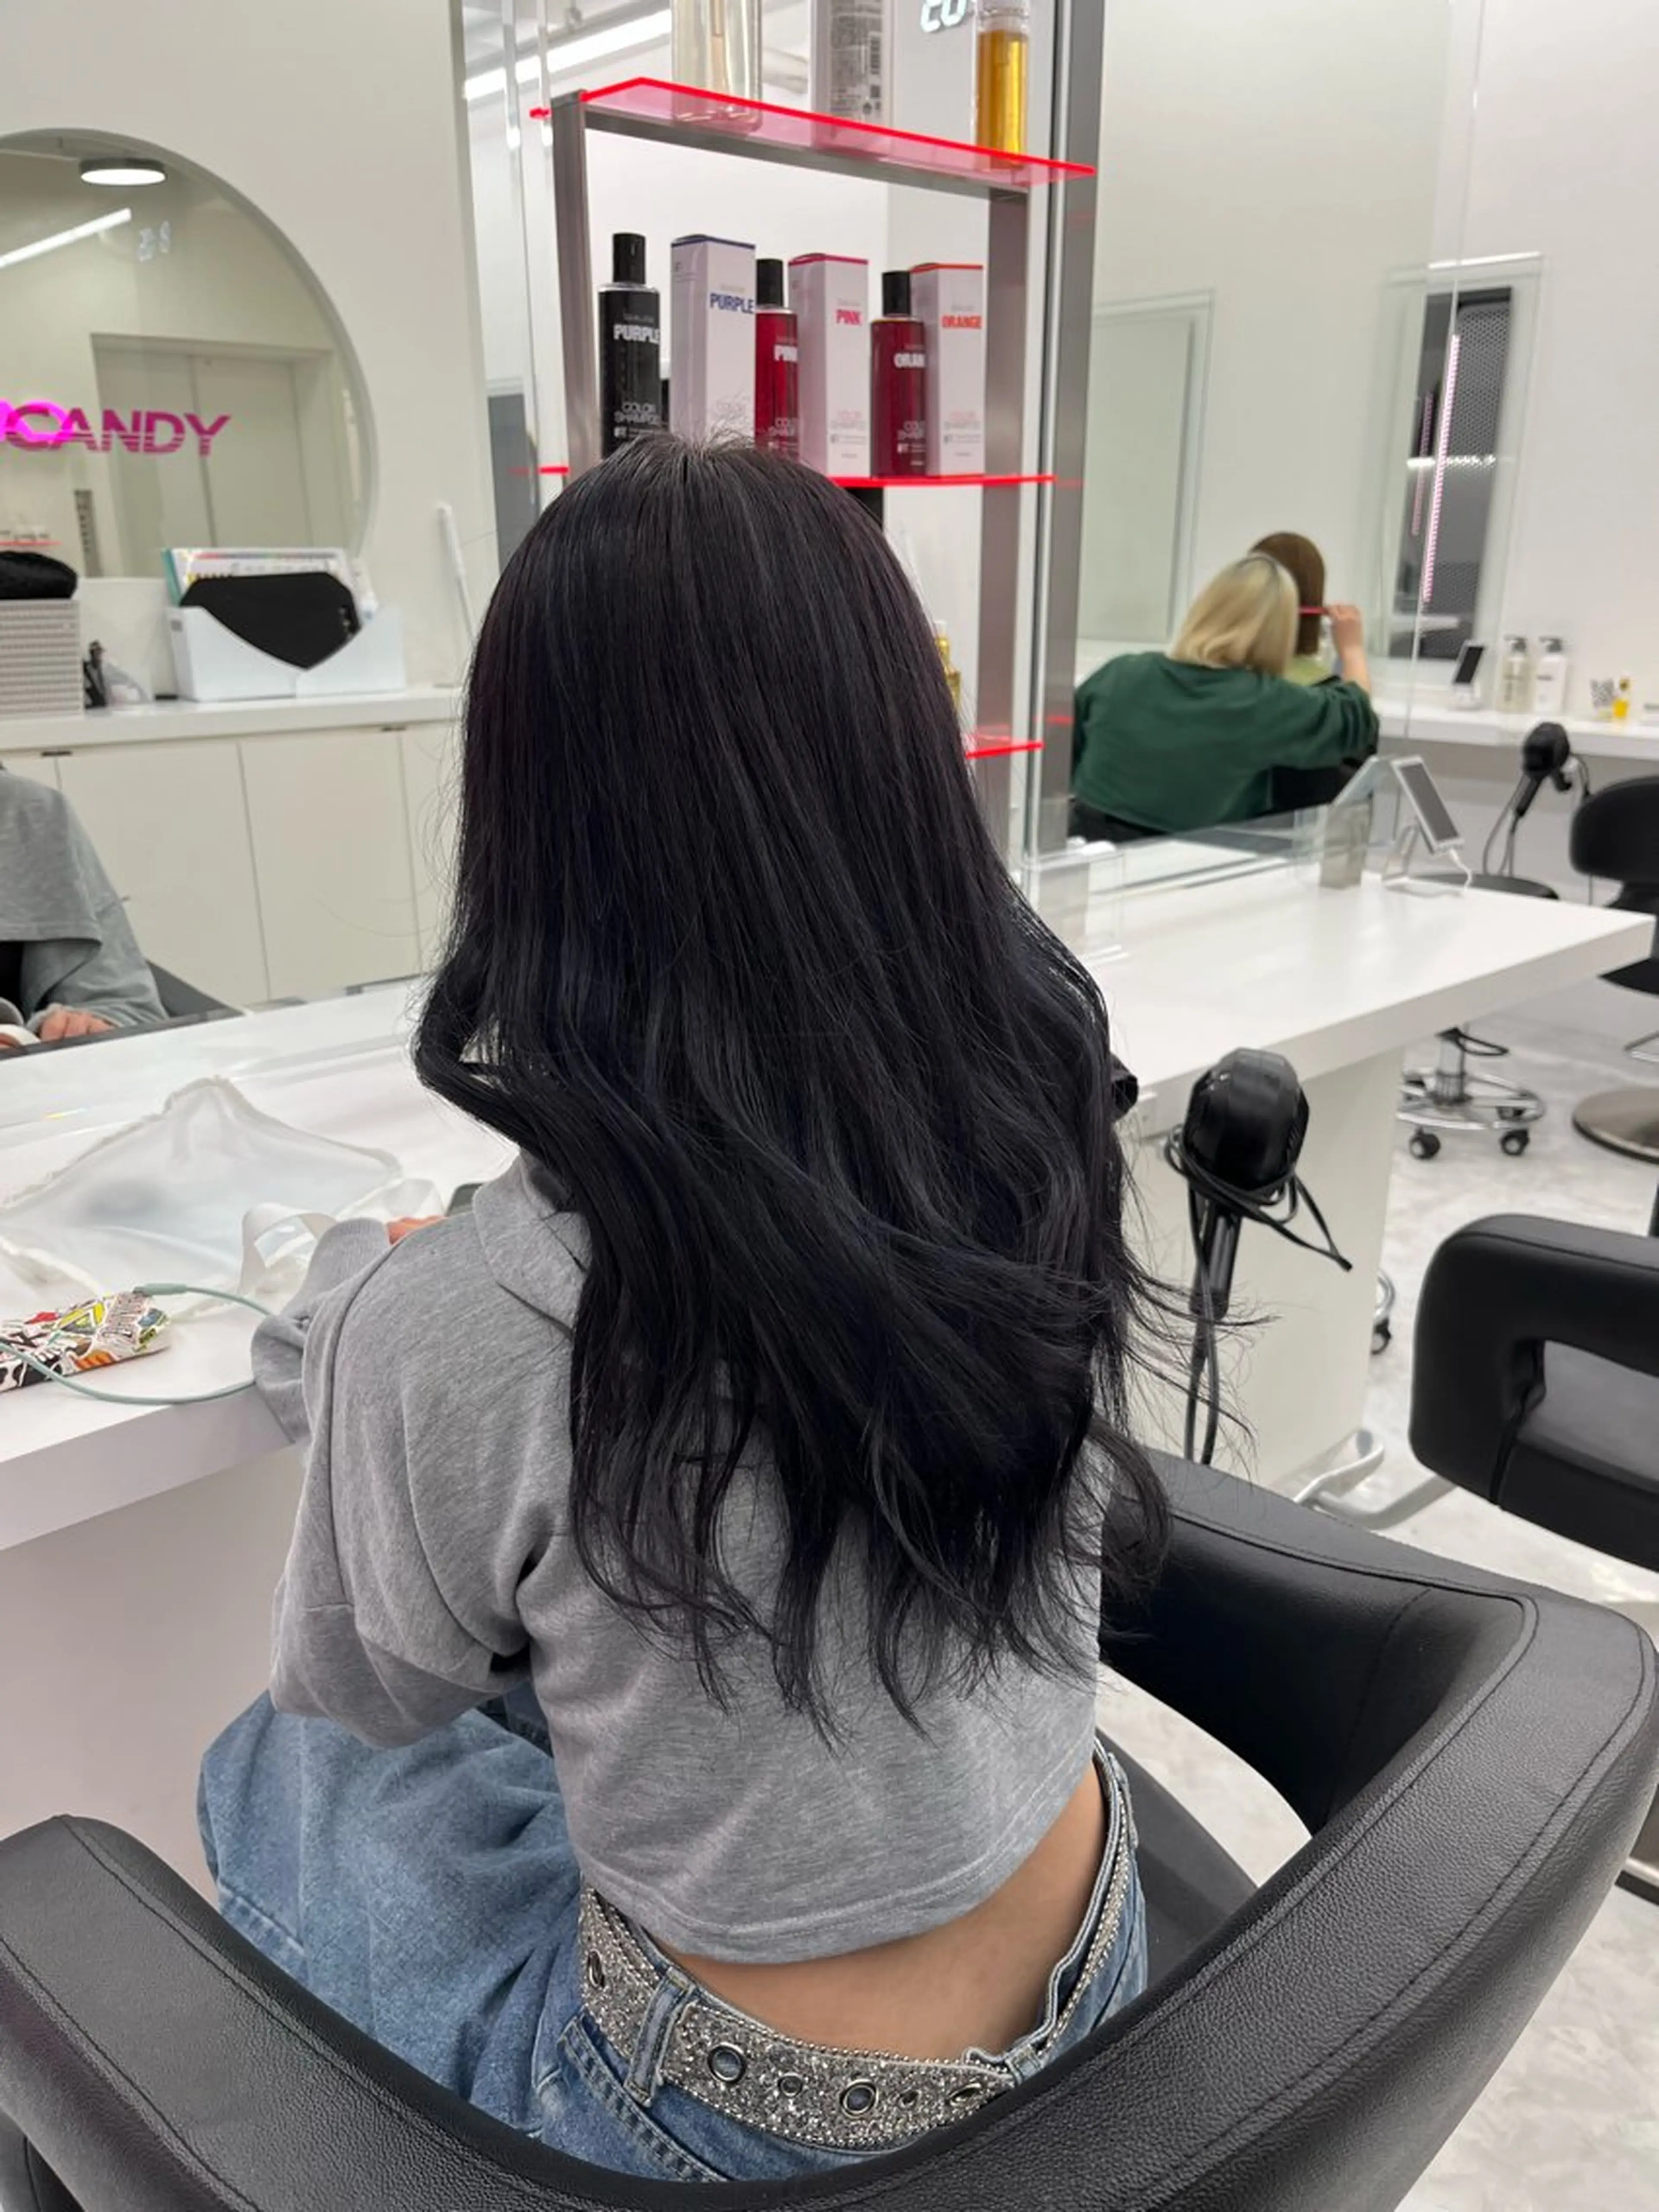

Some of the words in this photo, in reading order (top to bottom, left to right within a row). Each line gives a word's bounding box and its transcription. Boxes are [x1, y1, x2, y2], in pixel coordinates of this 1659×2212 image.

[710, 292, 754, 315] PURPLE
[836, 309, 861, 325] PINK
[942, 315, 982, 329] ORANGE
[893, 353, 926, 368] ORAN
